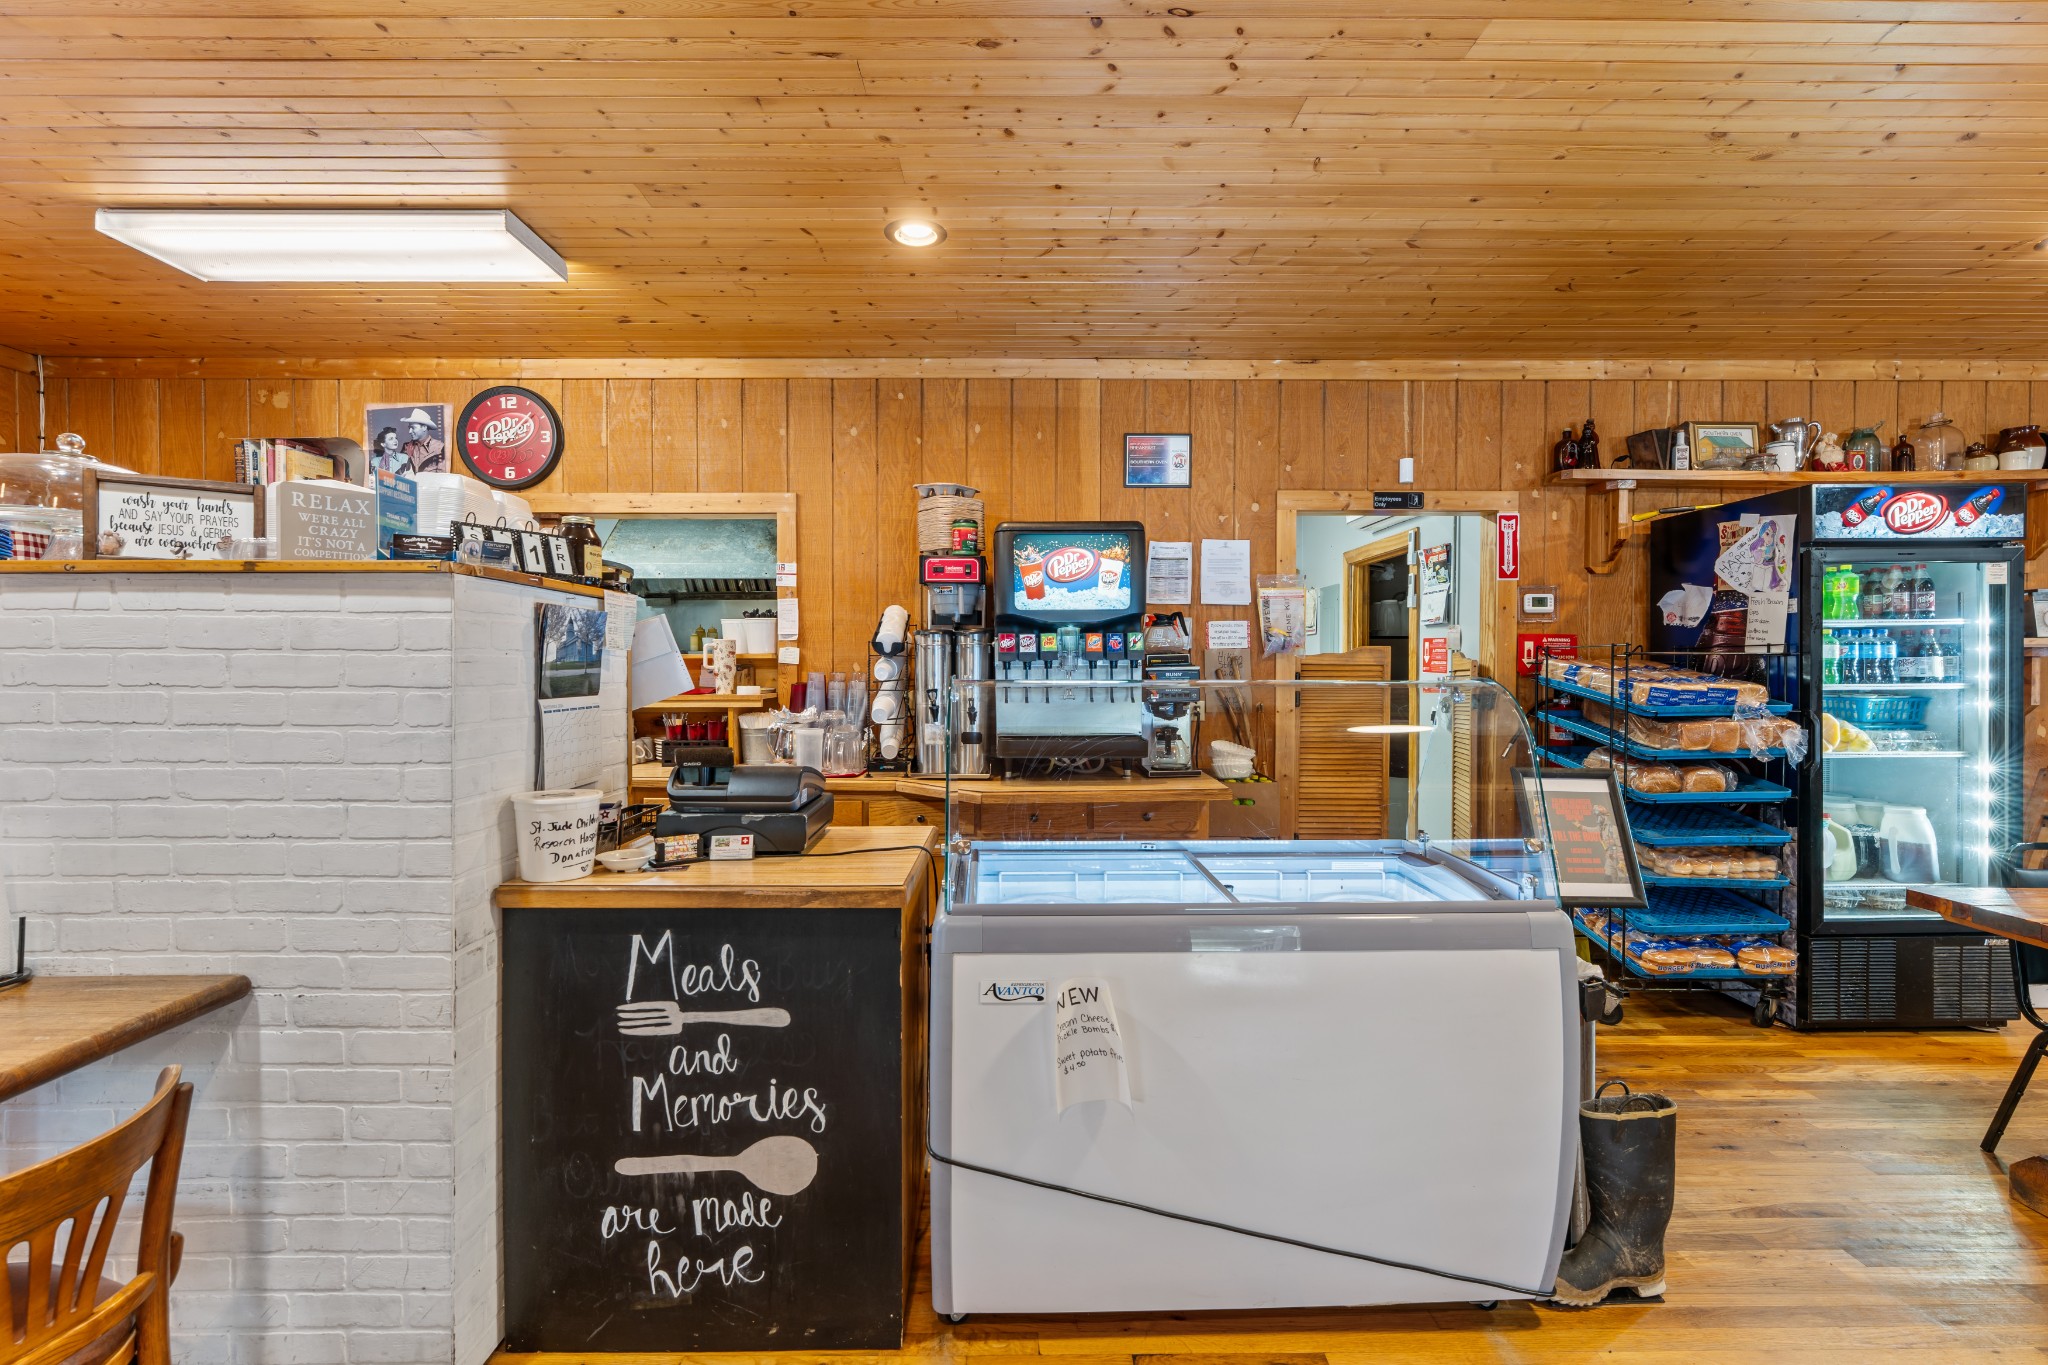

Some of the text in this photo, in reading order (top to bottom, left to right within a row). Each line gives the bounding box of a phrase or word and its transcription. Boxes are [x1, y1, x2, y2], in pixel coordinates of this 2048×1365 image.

[500, 396, 518, 408] 12
[501, 416, 518, 430] Dr
[468, 432, 478, 444] 9
[540, 430, 550, 442] 3
[504, 466, 516, 478] 6
[122, 492, 233, 515] wash your hands
[292, 491, 370, 516] RELAX
[1906, 498, 1926, 512] Dr
[118, 508, 238, 528] AND SAY YOUR PRAYERS
[298, 512, 366, 529] WE'RE ALL
[1893, 502, 1937, 528] Pepper
[110, 514, 154, 532] because
[158, 524, 184, 536] JESUS
[190, 526, 196, 538] &
[308, 525, 358, 538] CRAZY
[134, 536, 216, 552] are evewher
[298, 536, 366, 552] IT'S NOT A
[530, 545, 540, 565] 1
[556, 544, 566, 570] FRI
[1064, 552, 1080, 564] Dr
[1054, 556, 1091, 578] Pepper
[548, 820, 572, 832] Jude
[533, 836, 576, 852] Research
[626, 930, 760, 1002] Meals
[983, 982, 1044, 997] AVANTCO
[1056, 986, 1098, 1013] NEW
[1080, 1014, 1110, 1024] Cheese
[1083, 1026, 1110, 1034] Bombs
[670, 1034, 737, 1074] and
[1080, 1048, 1108, 1059] potato
[632, 1073, 826, 1134] Memories
[600, 1192, 782, 1239] are made
[648, 1240, 766, 1298] here
